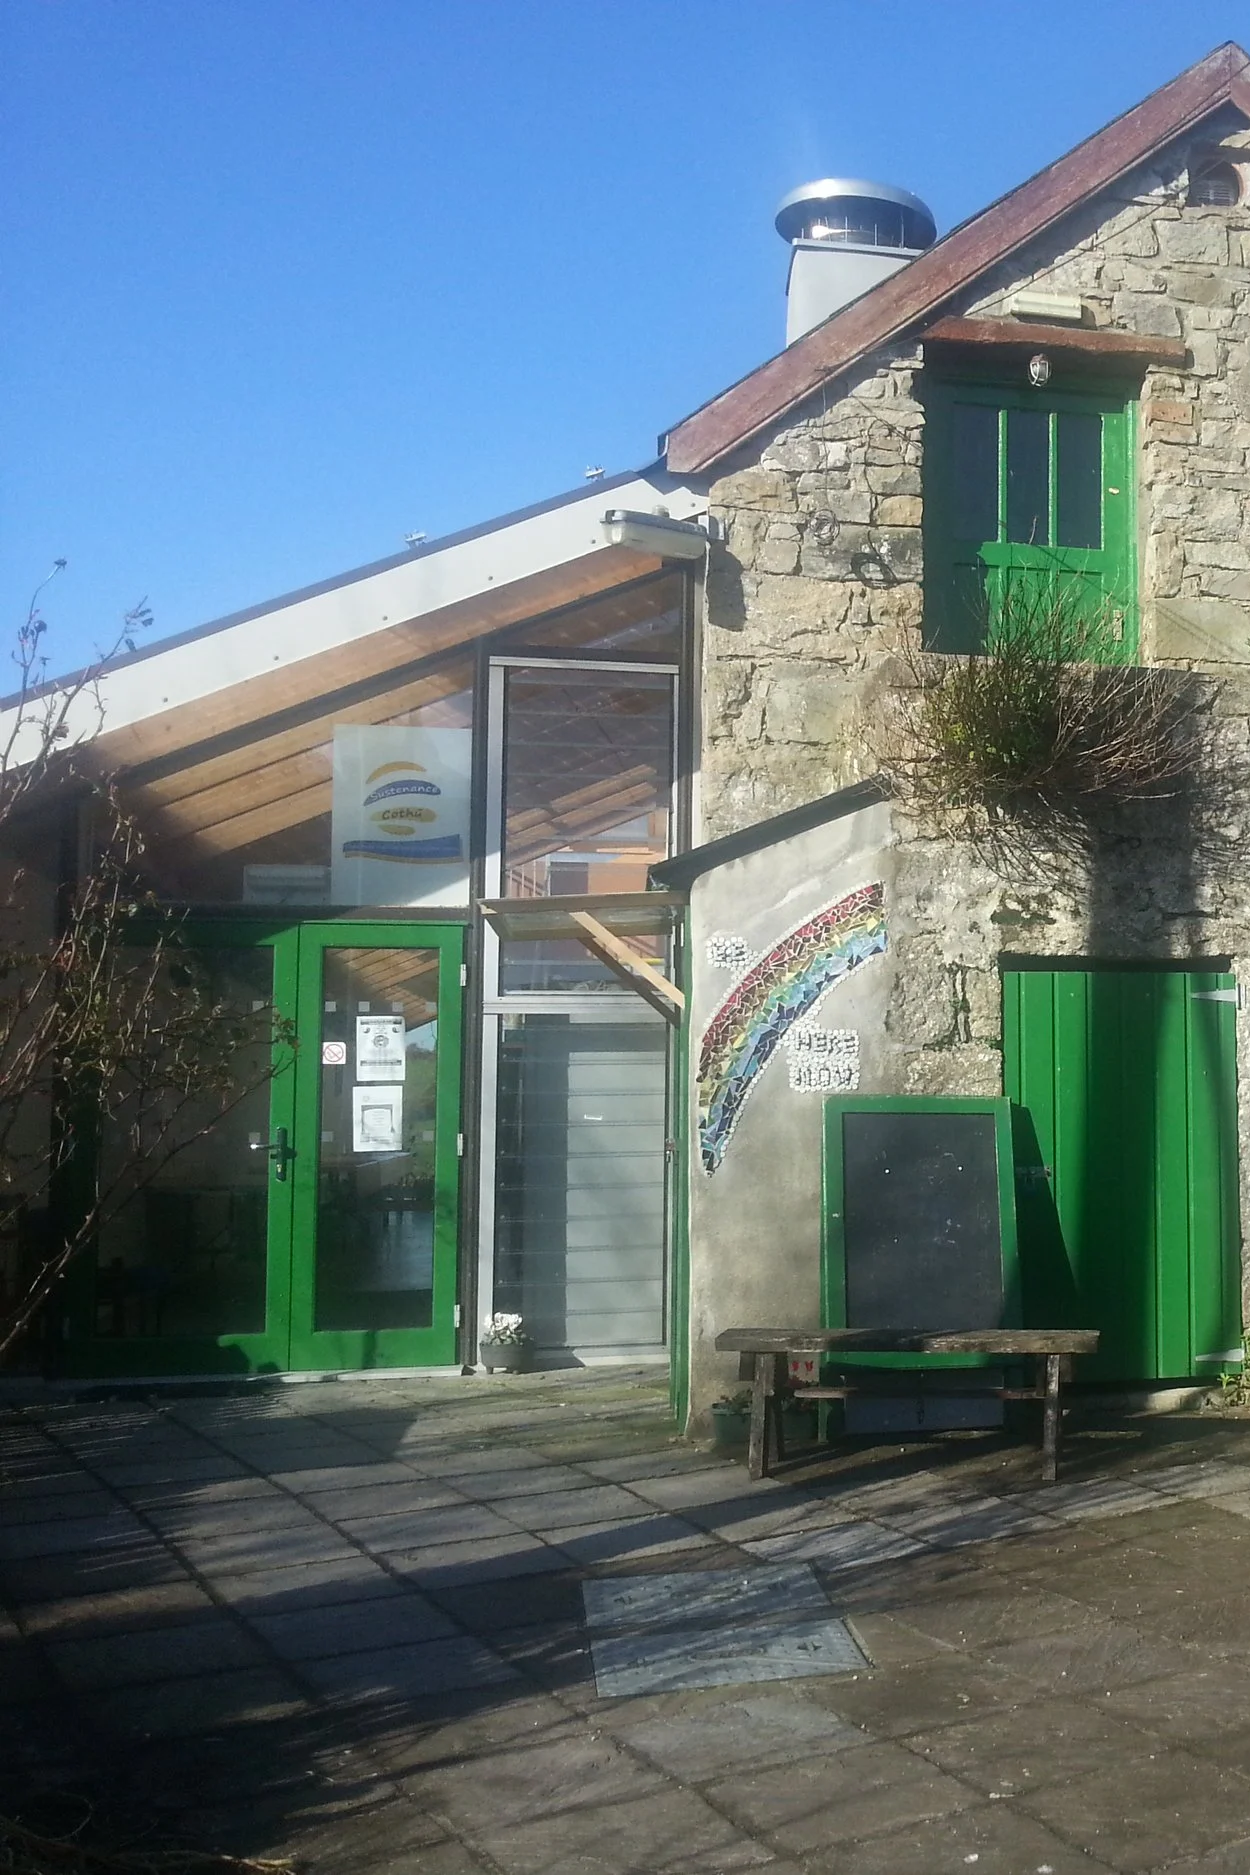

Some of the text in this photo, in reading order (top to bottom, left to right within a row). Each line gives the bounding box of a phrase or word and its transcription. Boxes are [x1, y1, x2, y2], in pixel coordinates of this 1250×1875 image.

[370, 785, 438, 801] Sustenance
[796, 1032, 857, 1055] HERE
[796, 1067, 854, 1087] NOW
